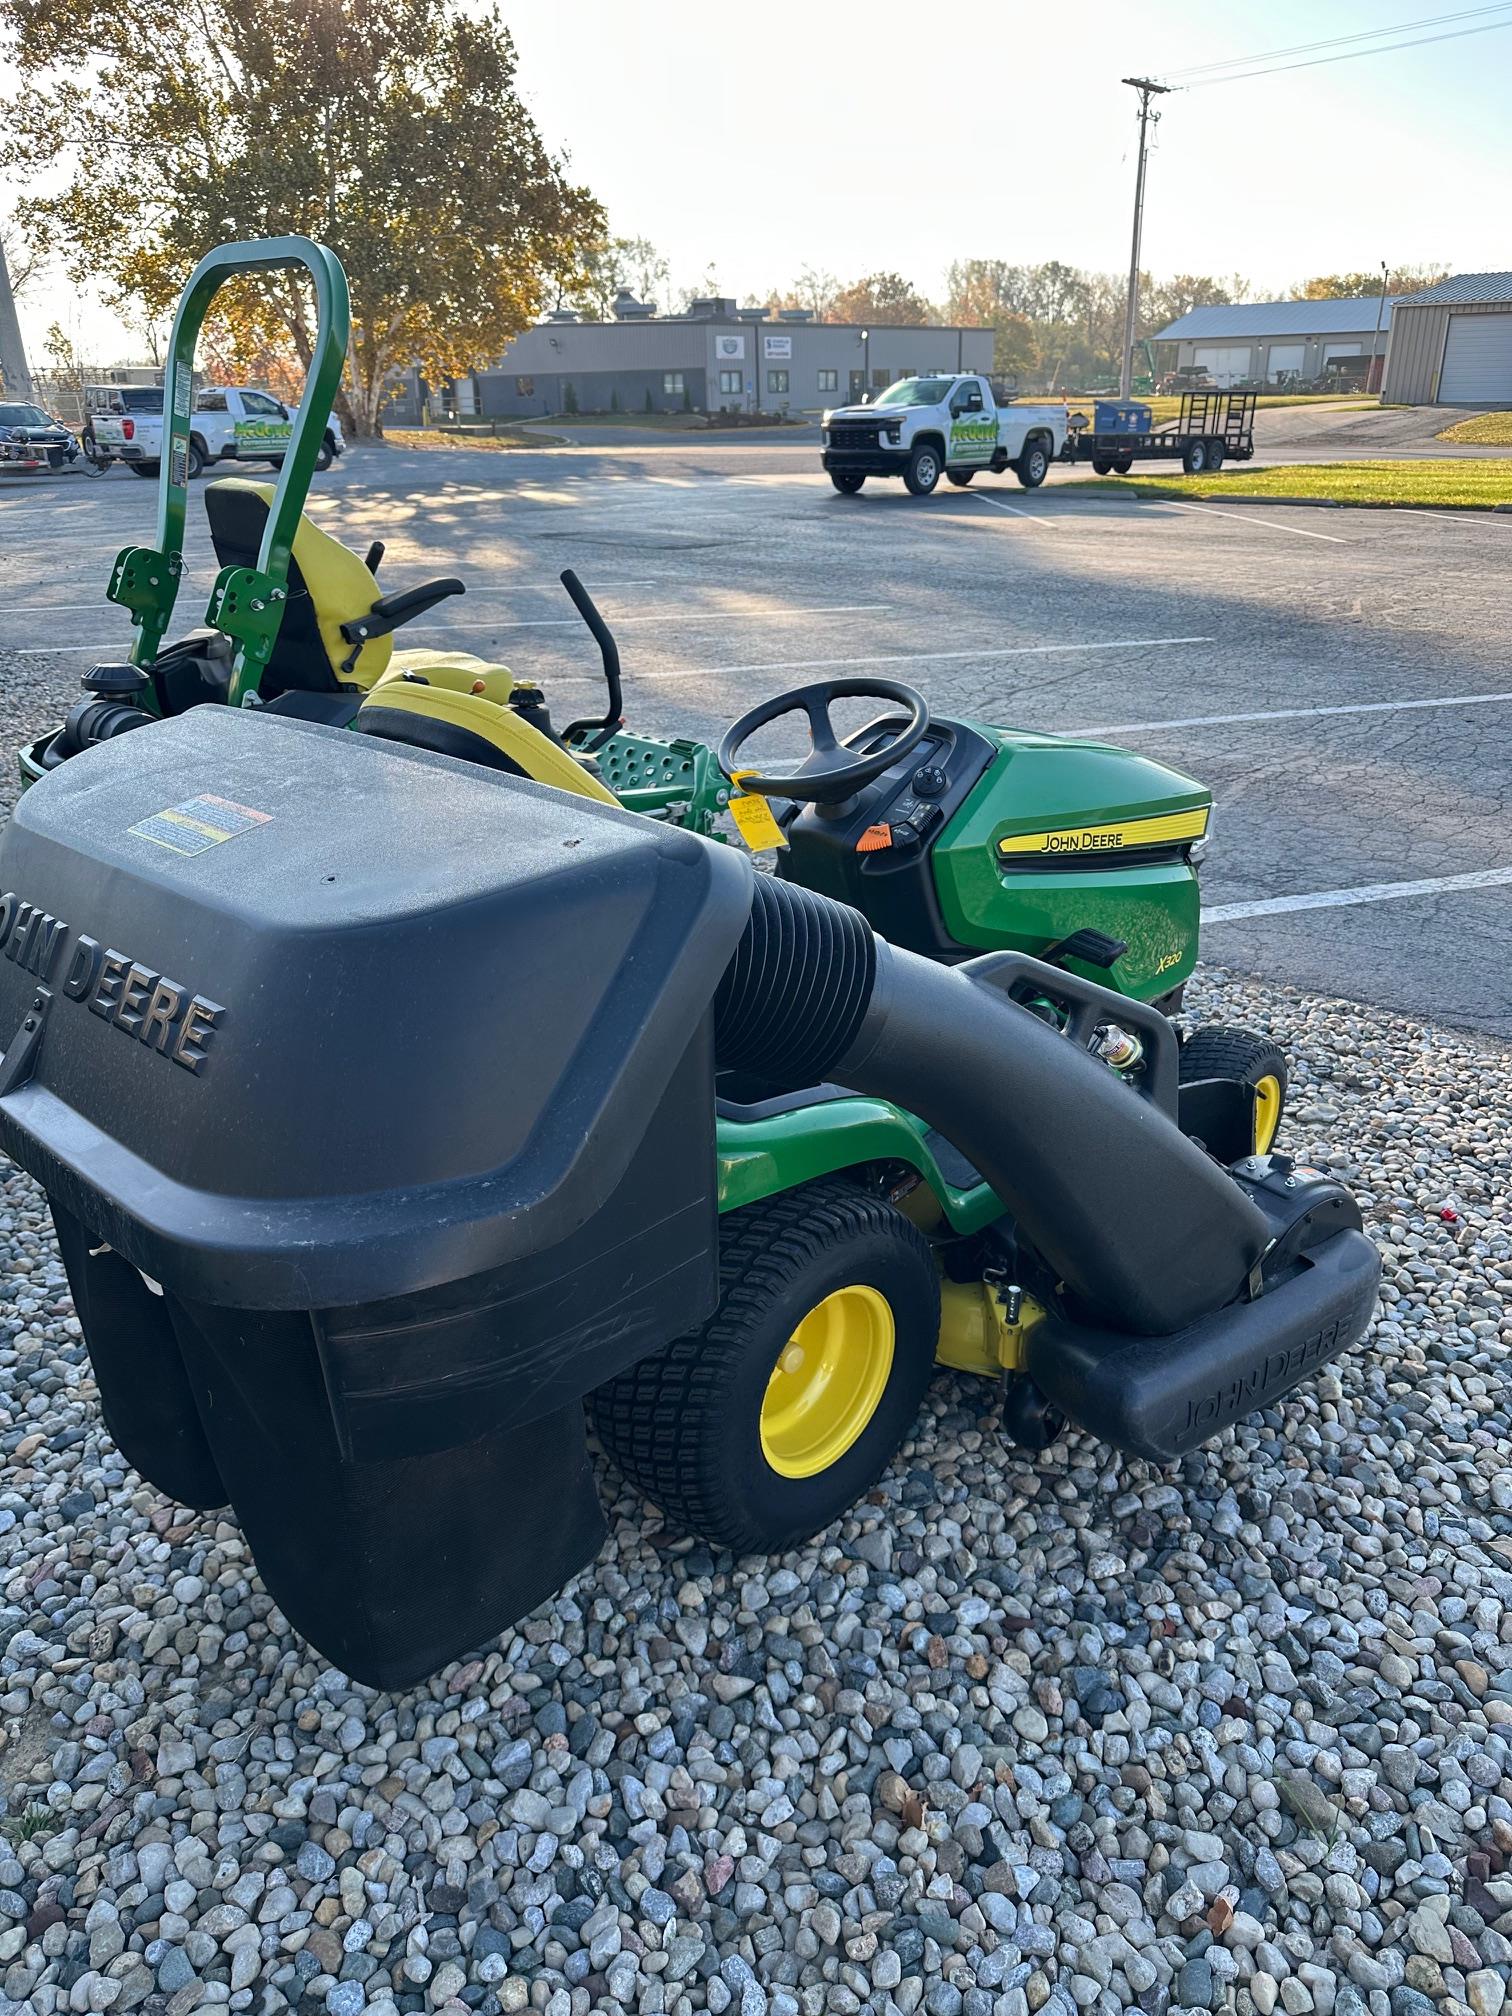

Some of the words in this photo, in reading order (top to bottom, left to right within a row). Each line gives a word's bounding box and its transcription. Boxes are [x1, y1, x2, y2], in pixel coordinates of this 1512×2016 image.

[1041, 835, 1079, 851] JOHN
[1082, 832, 1123, 847] DEERE
[0, 891, 68, 984] OHN
[62, 933, 226, 1078] DEERE
[1155, 951, 1182, 975] X320
[1175, 1370, 1259, 1443] JOHN
[1262, 1314, 1353, 1391] DEERE
